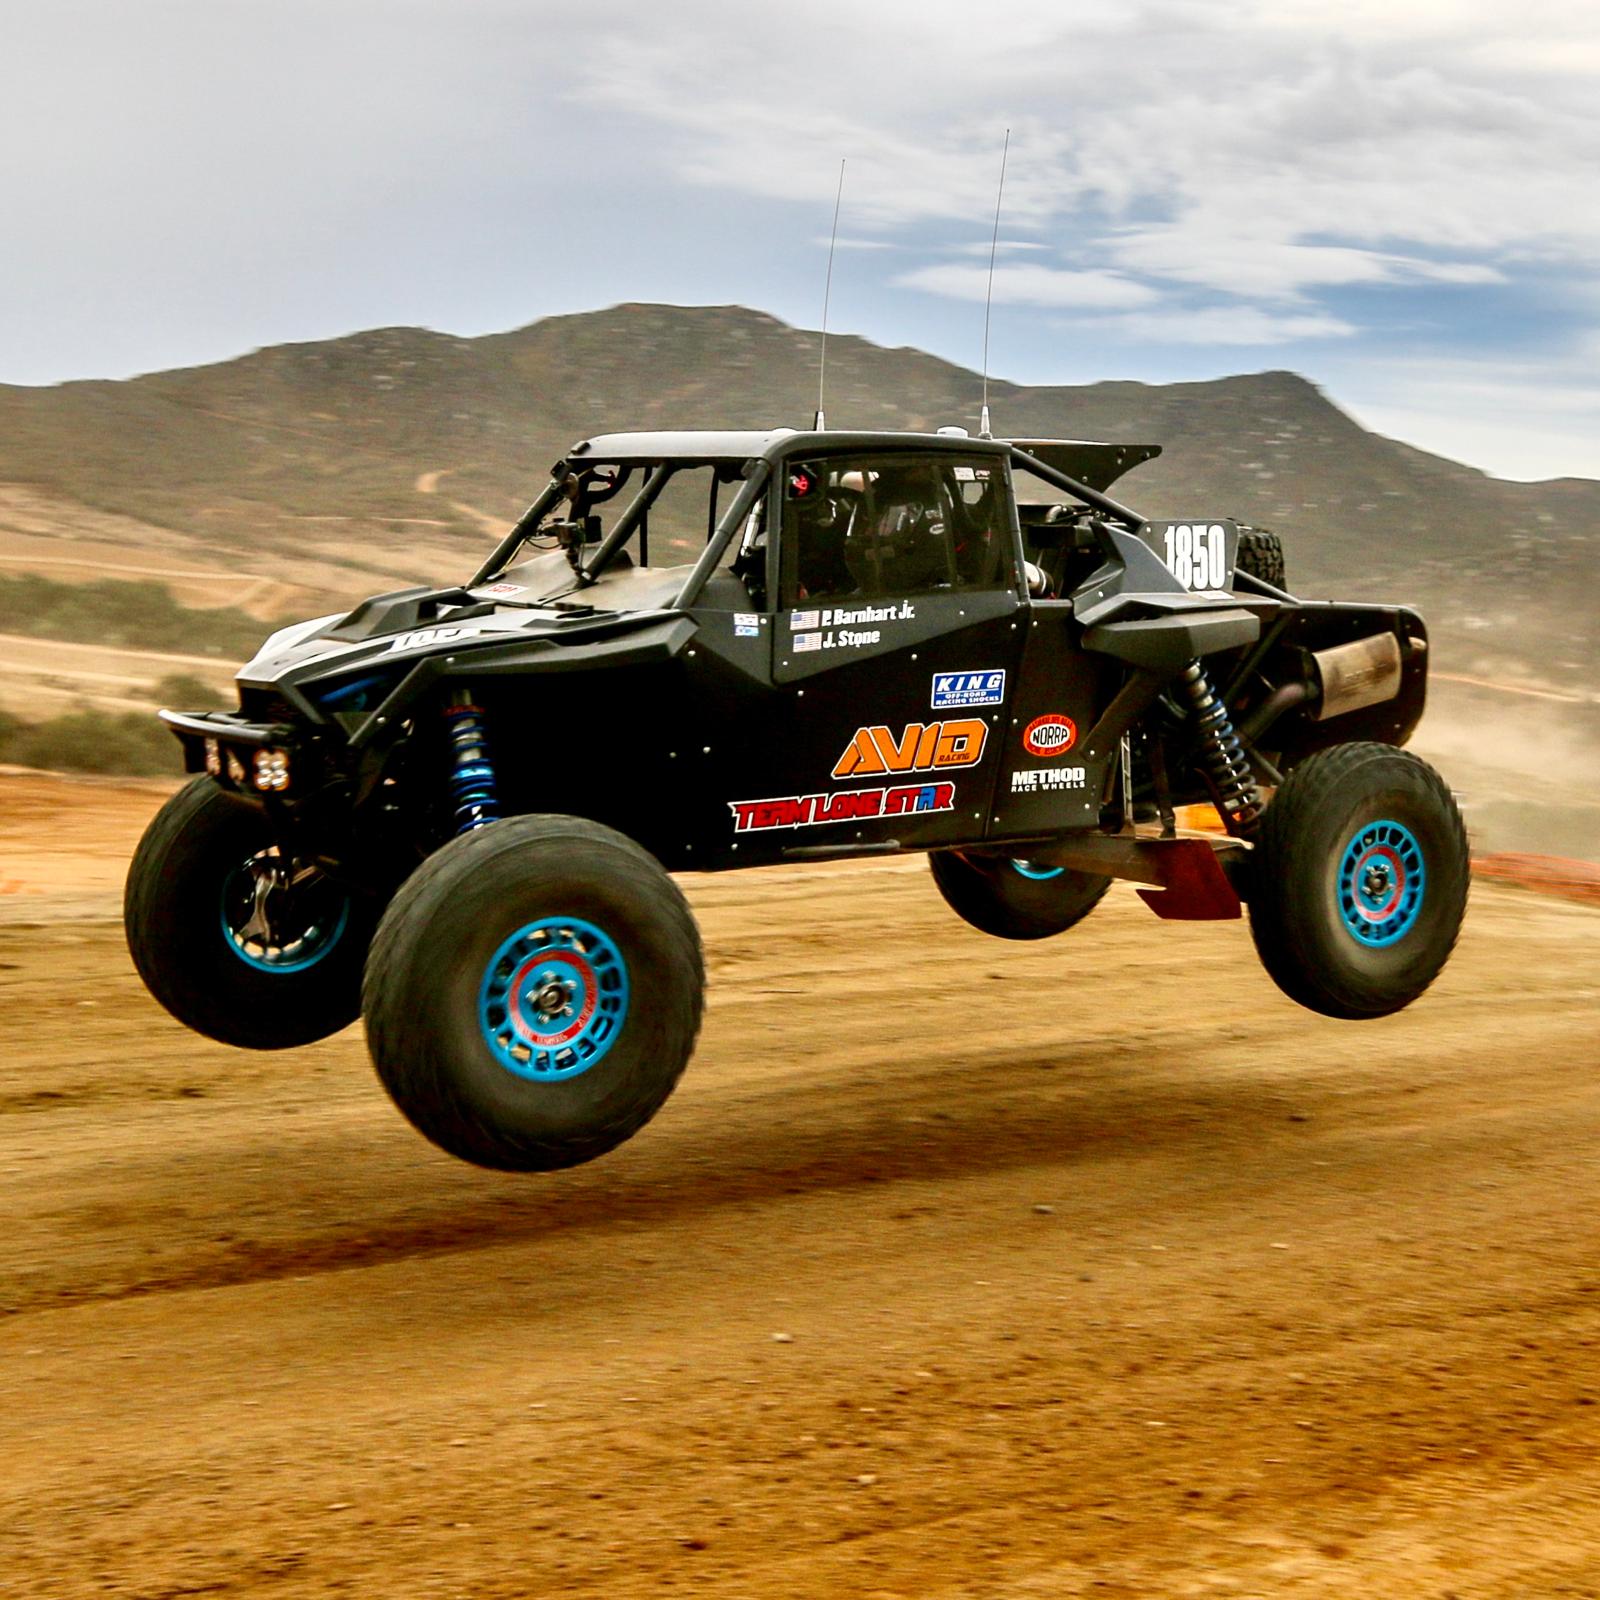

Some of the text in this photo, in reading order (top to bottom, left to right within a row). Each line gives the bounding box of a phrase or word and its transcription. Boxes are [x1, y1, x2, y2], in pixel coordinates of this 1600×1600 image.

[1164, 525, 1225, 589] 1850
[833, 605, 897, 625] Barnhart
[898, 603, 915, 619] Jr.
[822, 630, 881, 648] J. Stone
[936, 674, 1002, 692] KING
[945, 691, 987, 699] OFF-ROAD
[831, 718, 989, 780] AVID
[938, 752, 970, 762] RACING
[1012, 767, 1085, 785] METHOD
[1042, 781, 1085, 790] WHEELS
[729, 782, 955, 832] TEAM LONE STAR
